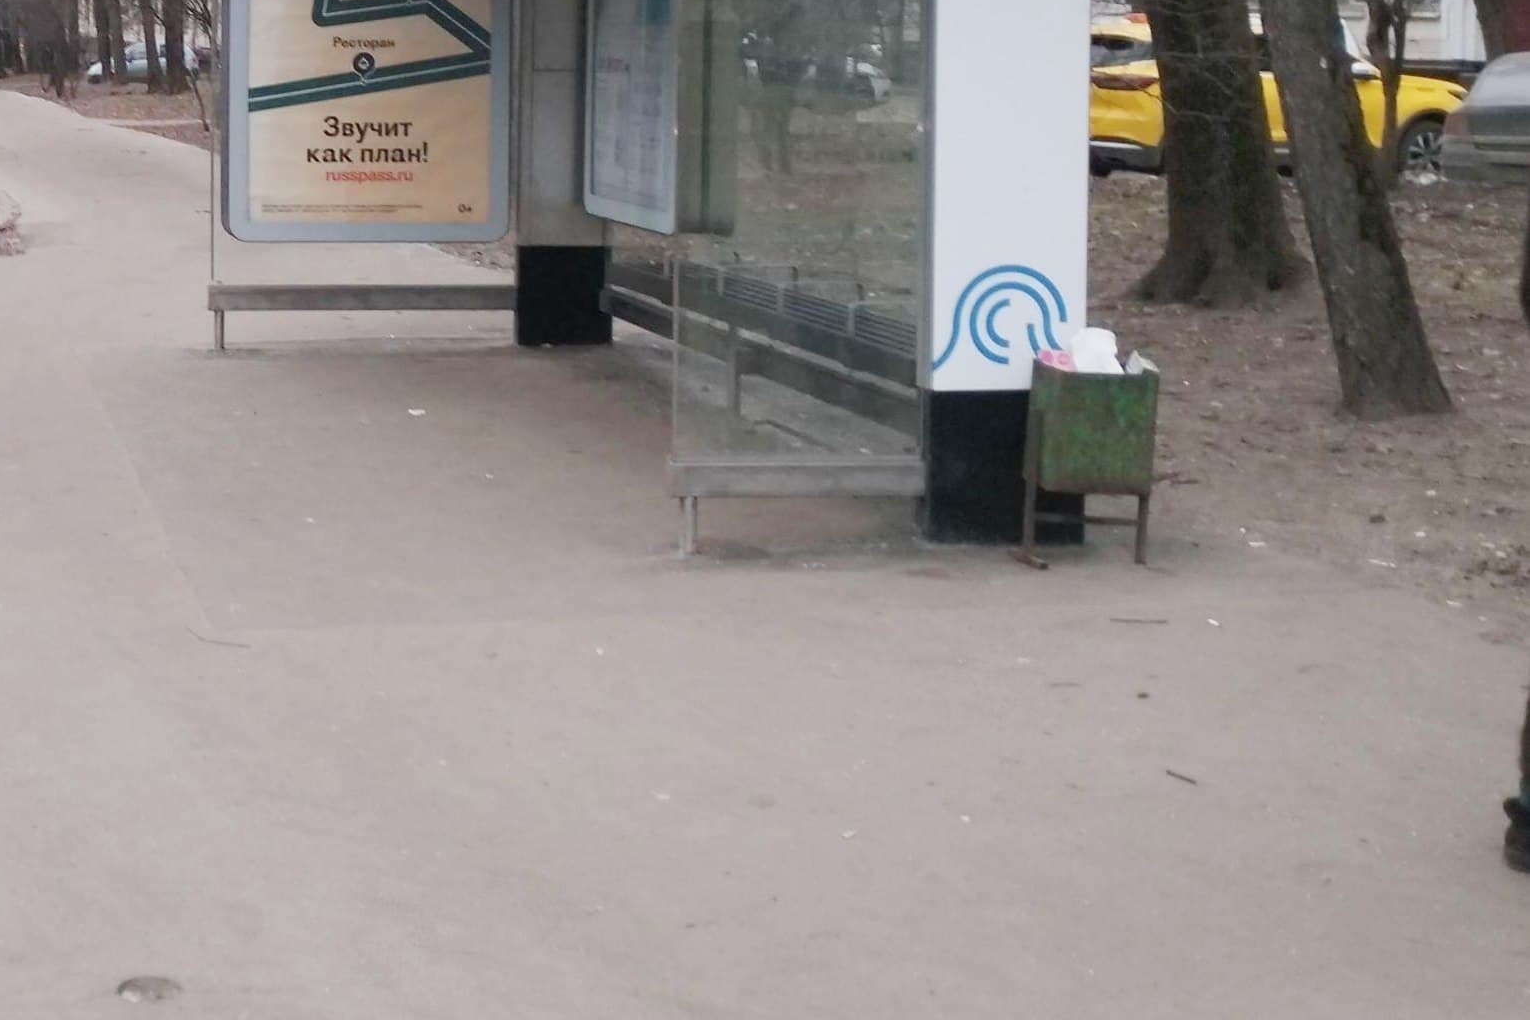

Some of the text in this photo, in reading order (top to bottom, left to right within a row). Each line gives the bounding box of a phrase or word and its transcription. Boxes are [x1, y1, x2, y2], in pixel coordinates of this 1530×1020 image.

[333, 36, 396, 50] Ресторан
[323, 116, 412, 143] Звучит
[306, 141, 429, 163] как план!
[325, 169, 413, 184] russpass.ru
